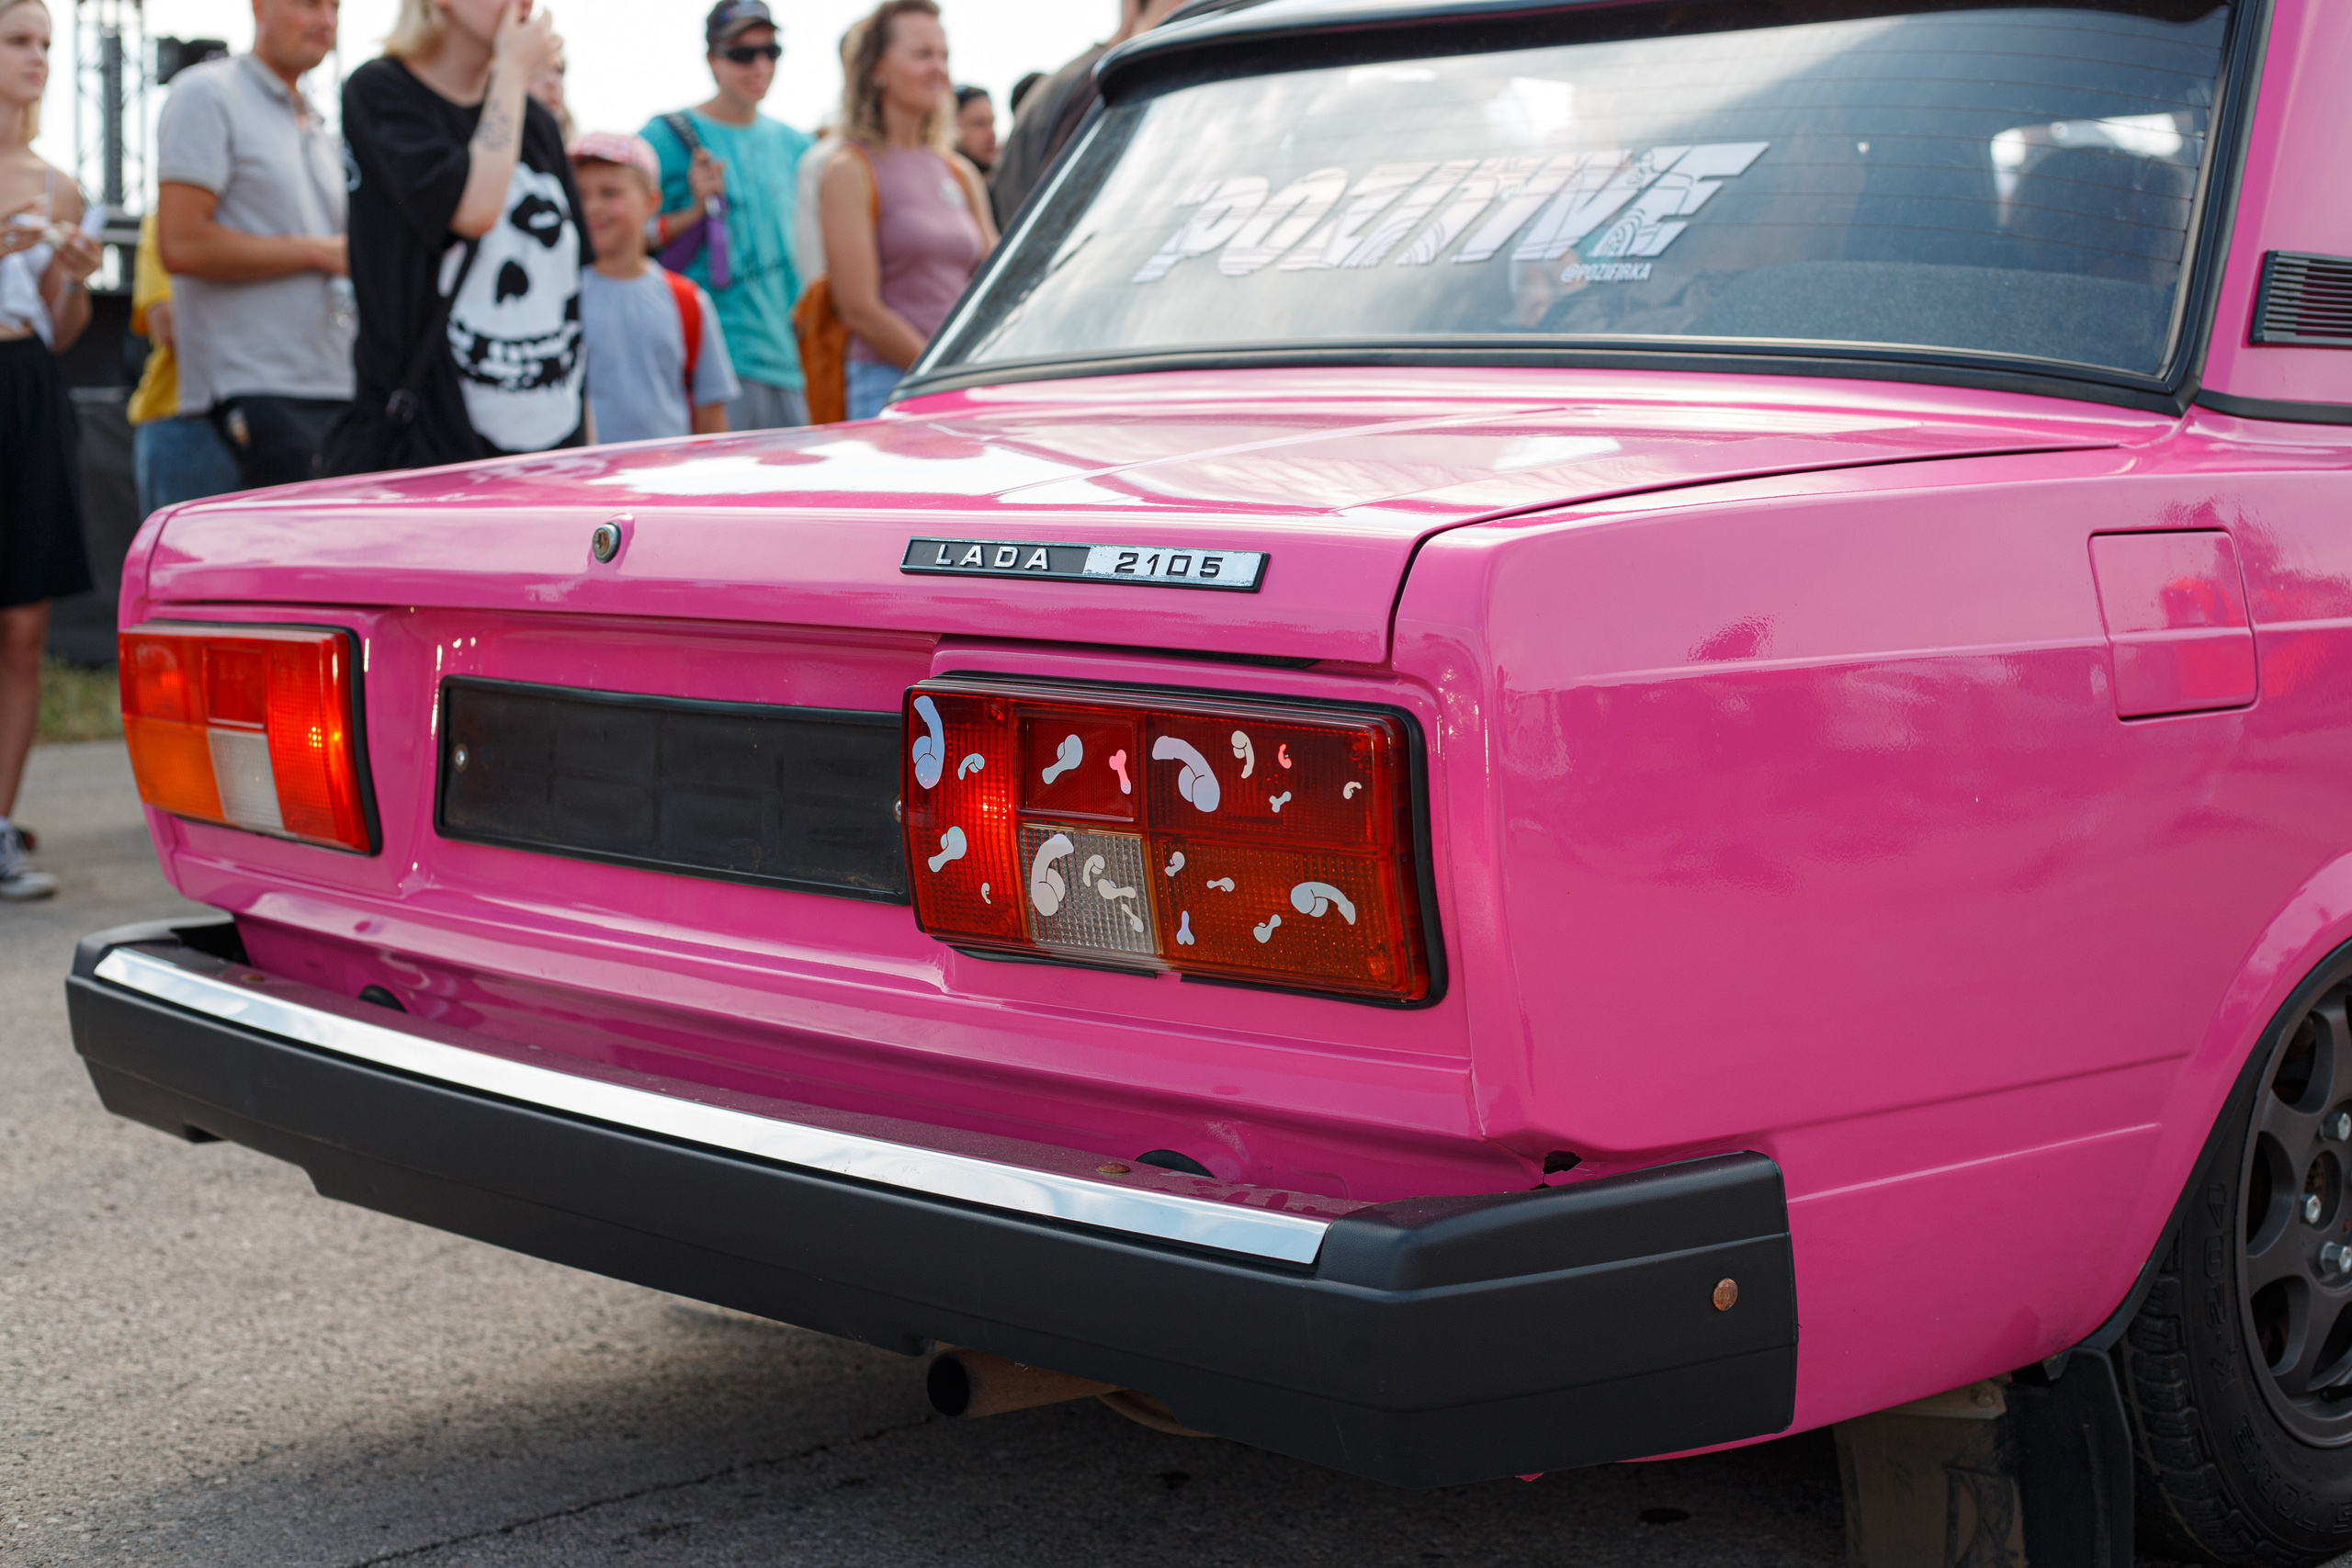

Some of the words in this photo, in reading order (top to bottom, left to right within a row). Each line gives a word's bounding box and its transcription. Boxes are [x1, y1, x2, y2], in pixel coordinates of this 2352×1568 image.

[1132, 141, 1770, 284] POZITIVE
[935, 544, 1049, 570] LADA
[1114, 552, 1224, 578] 2105
